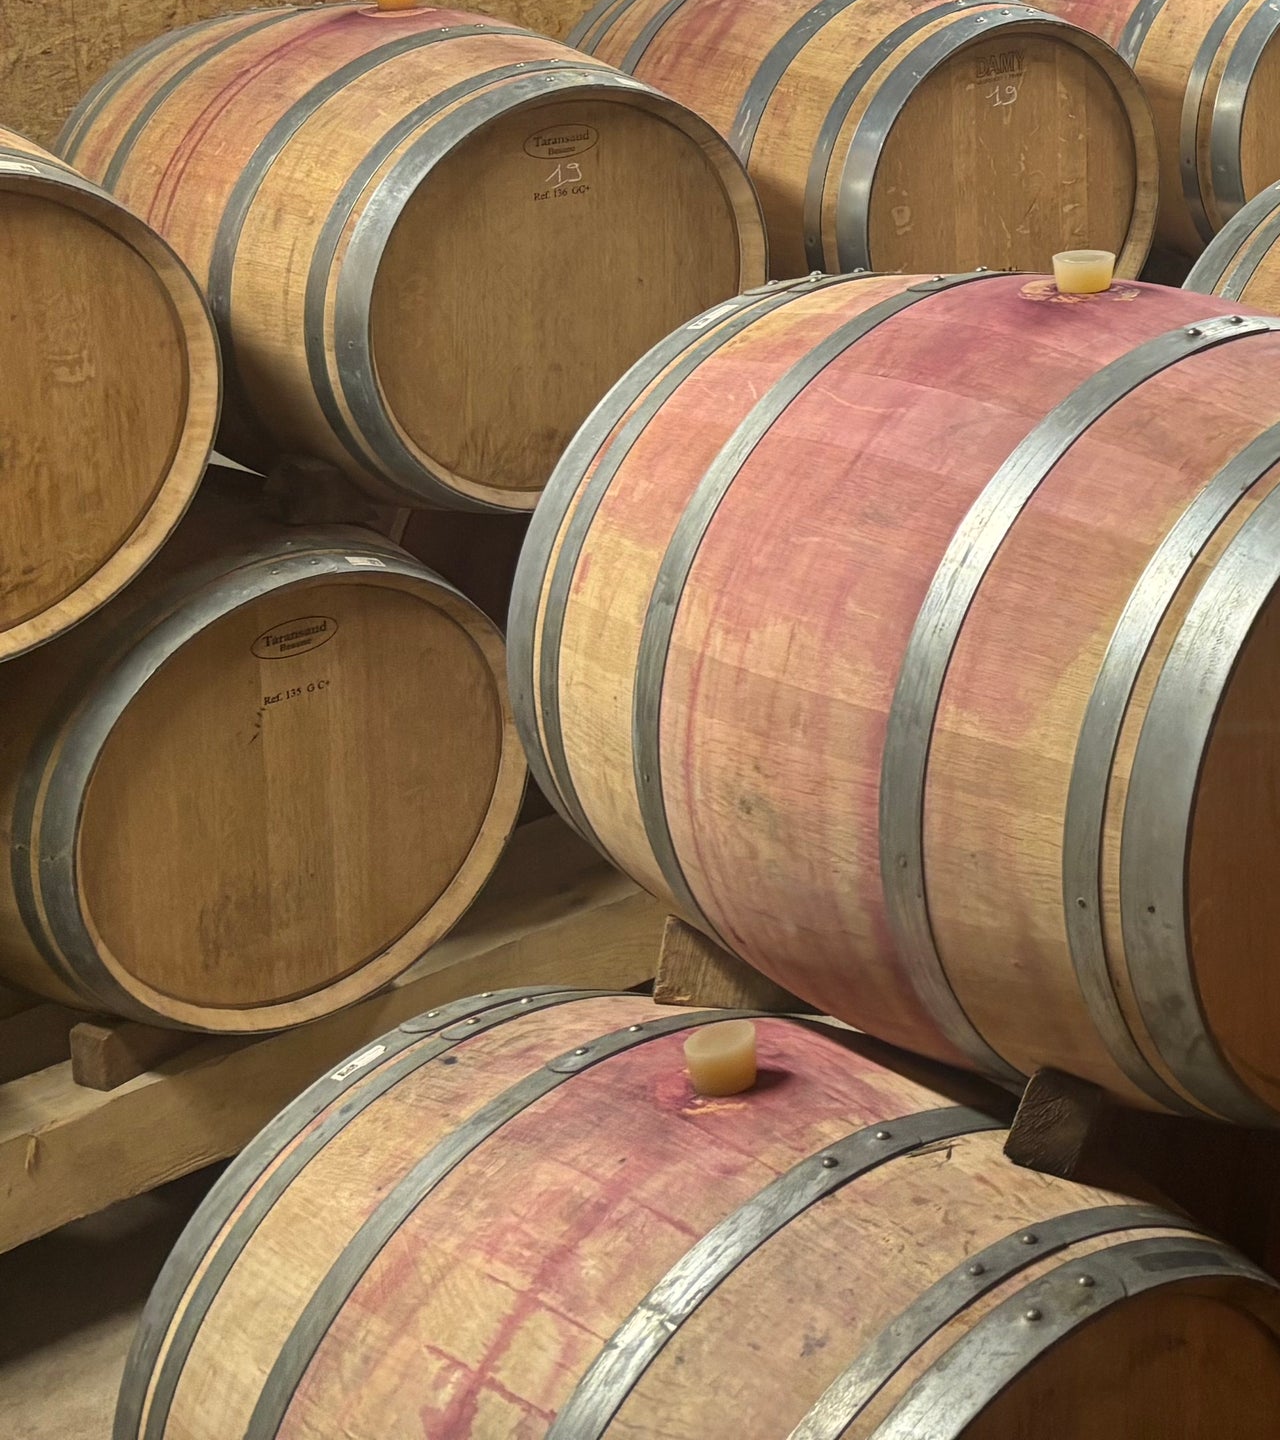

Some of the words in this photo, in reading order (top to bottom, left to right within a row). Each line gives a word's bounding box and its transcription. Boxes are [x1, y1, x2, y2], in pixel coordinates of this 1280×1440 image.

[976, 48, 1024, 78] DAMY
[985, 85, 1018, 107] 19
[545, 162, 582, 189] 19
